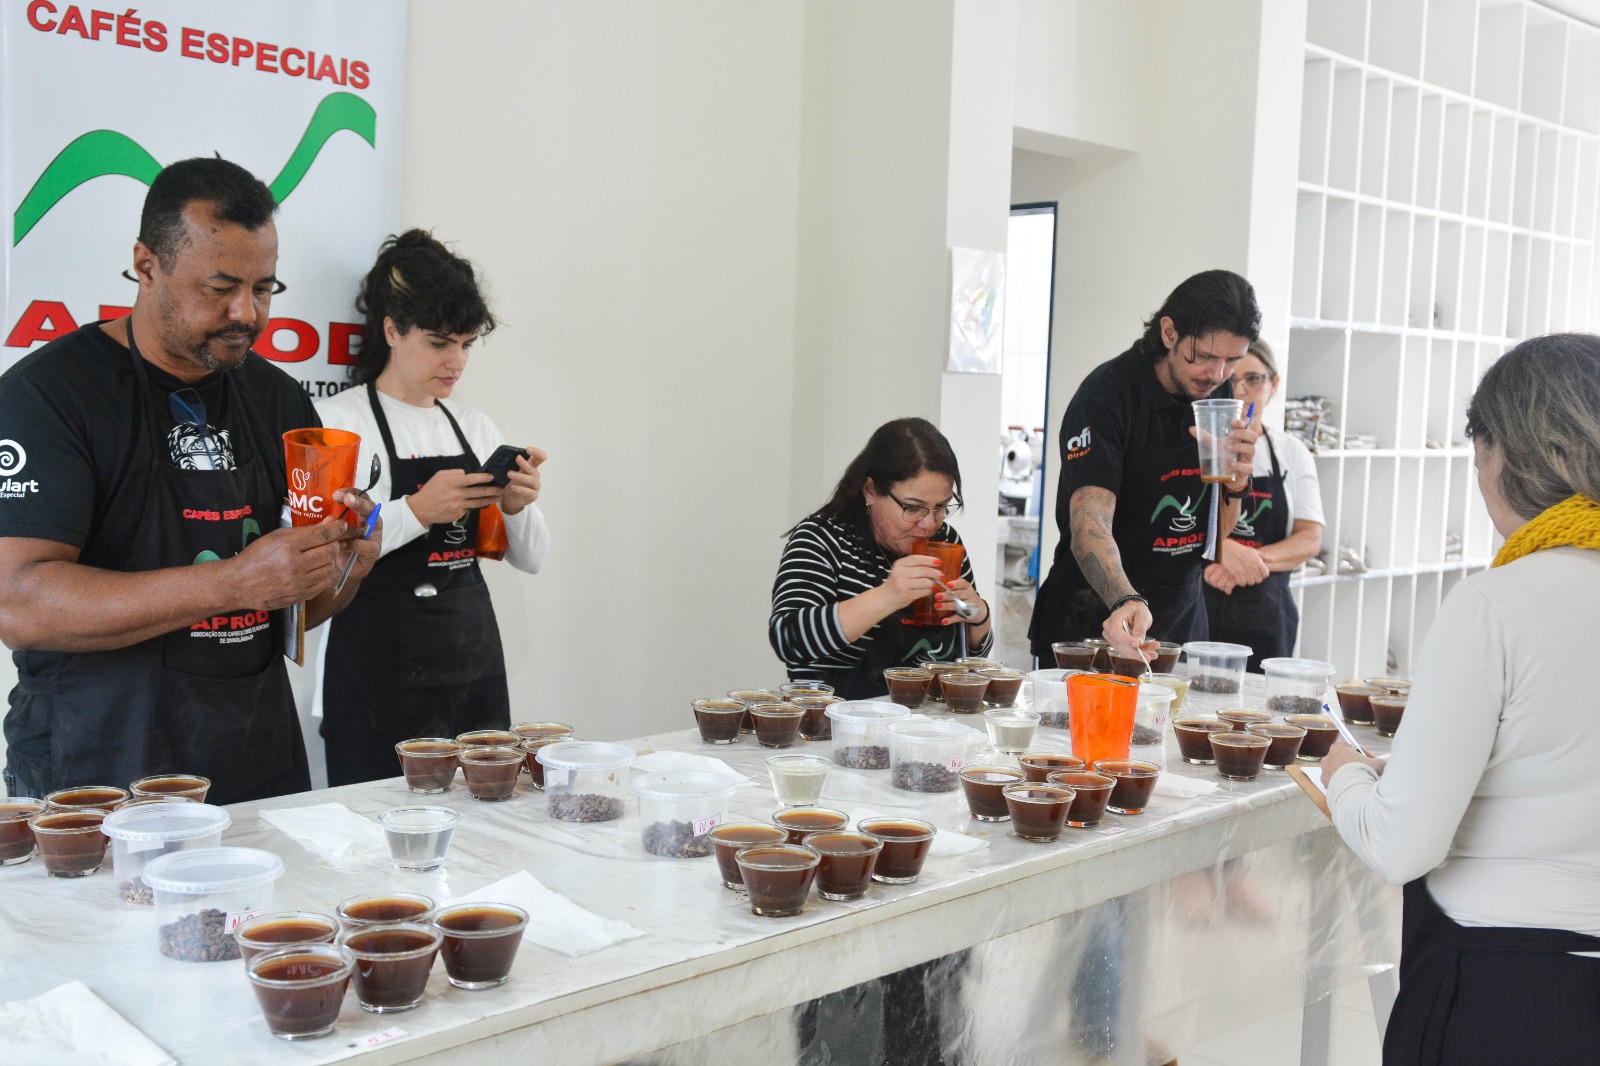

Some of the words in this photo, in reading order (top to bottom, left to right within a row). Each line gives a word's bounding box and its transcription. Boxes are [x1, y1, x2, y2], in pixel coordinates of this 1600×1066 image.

[27, 0, 168, 52] CAFÉS
[181, 27, 370, 90] ESPECIAIS
[183, 508, 220, 521] CAFÉS
[191, 610, 269, 630] APROD
